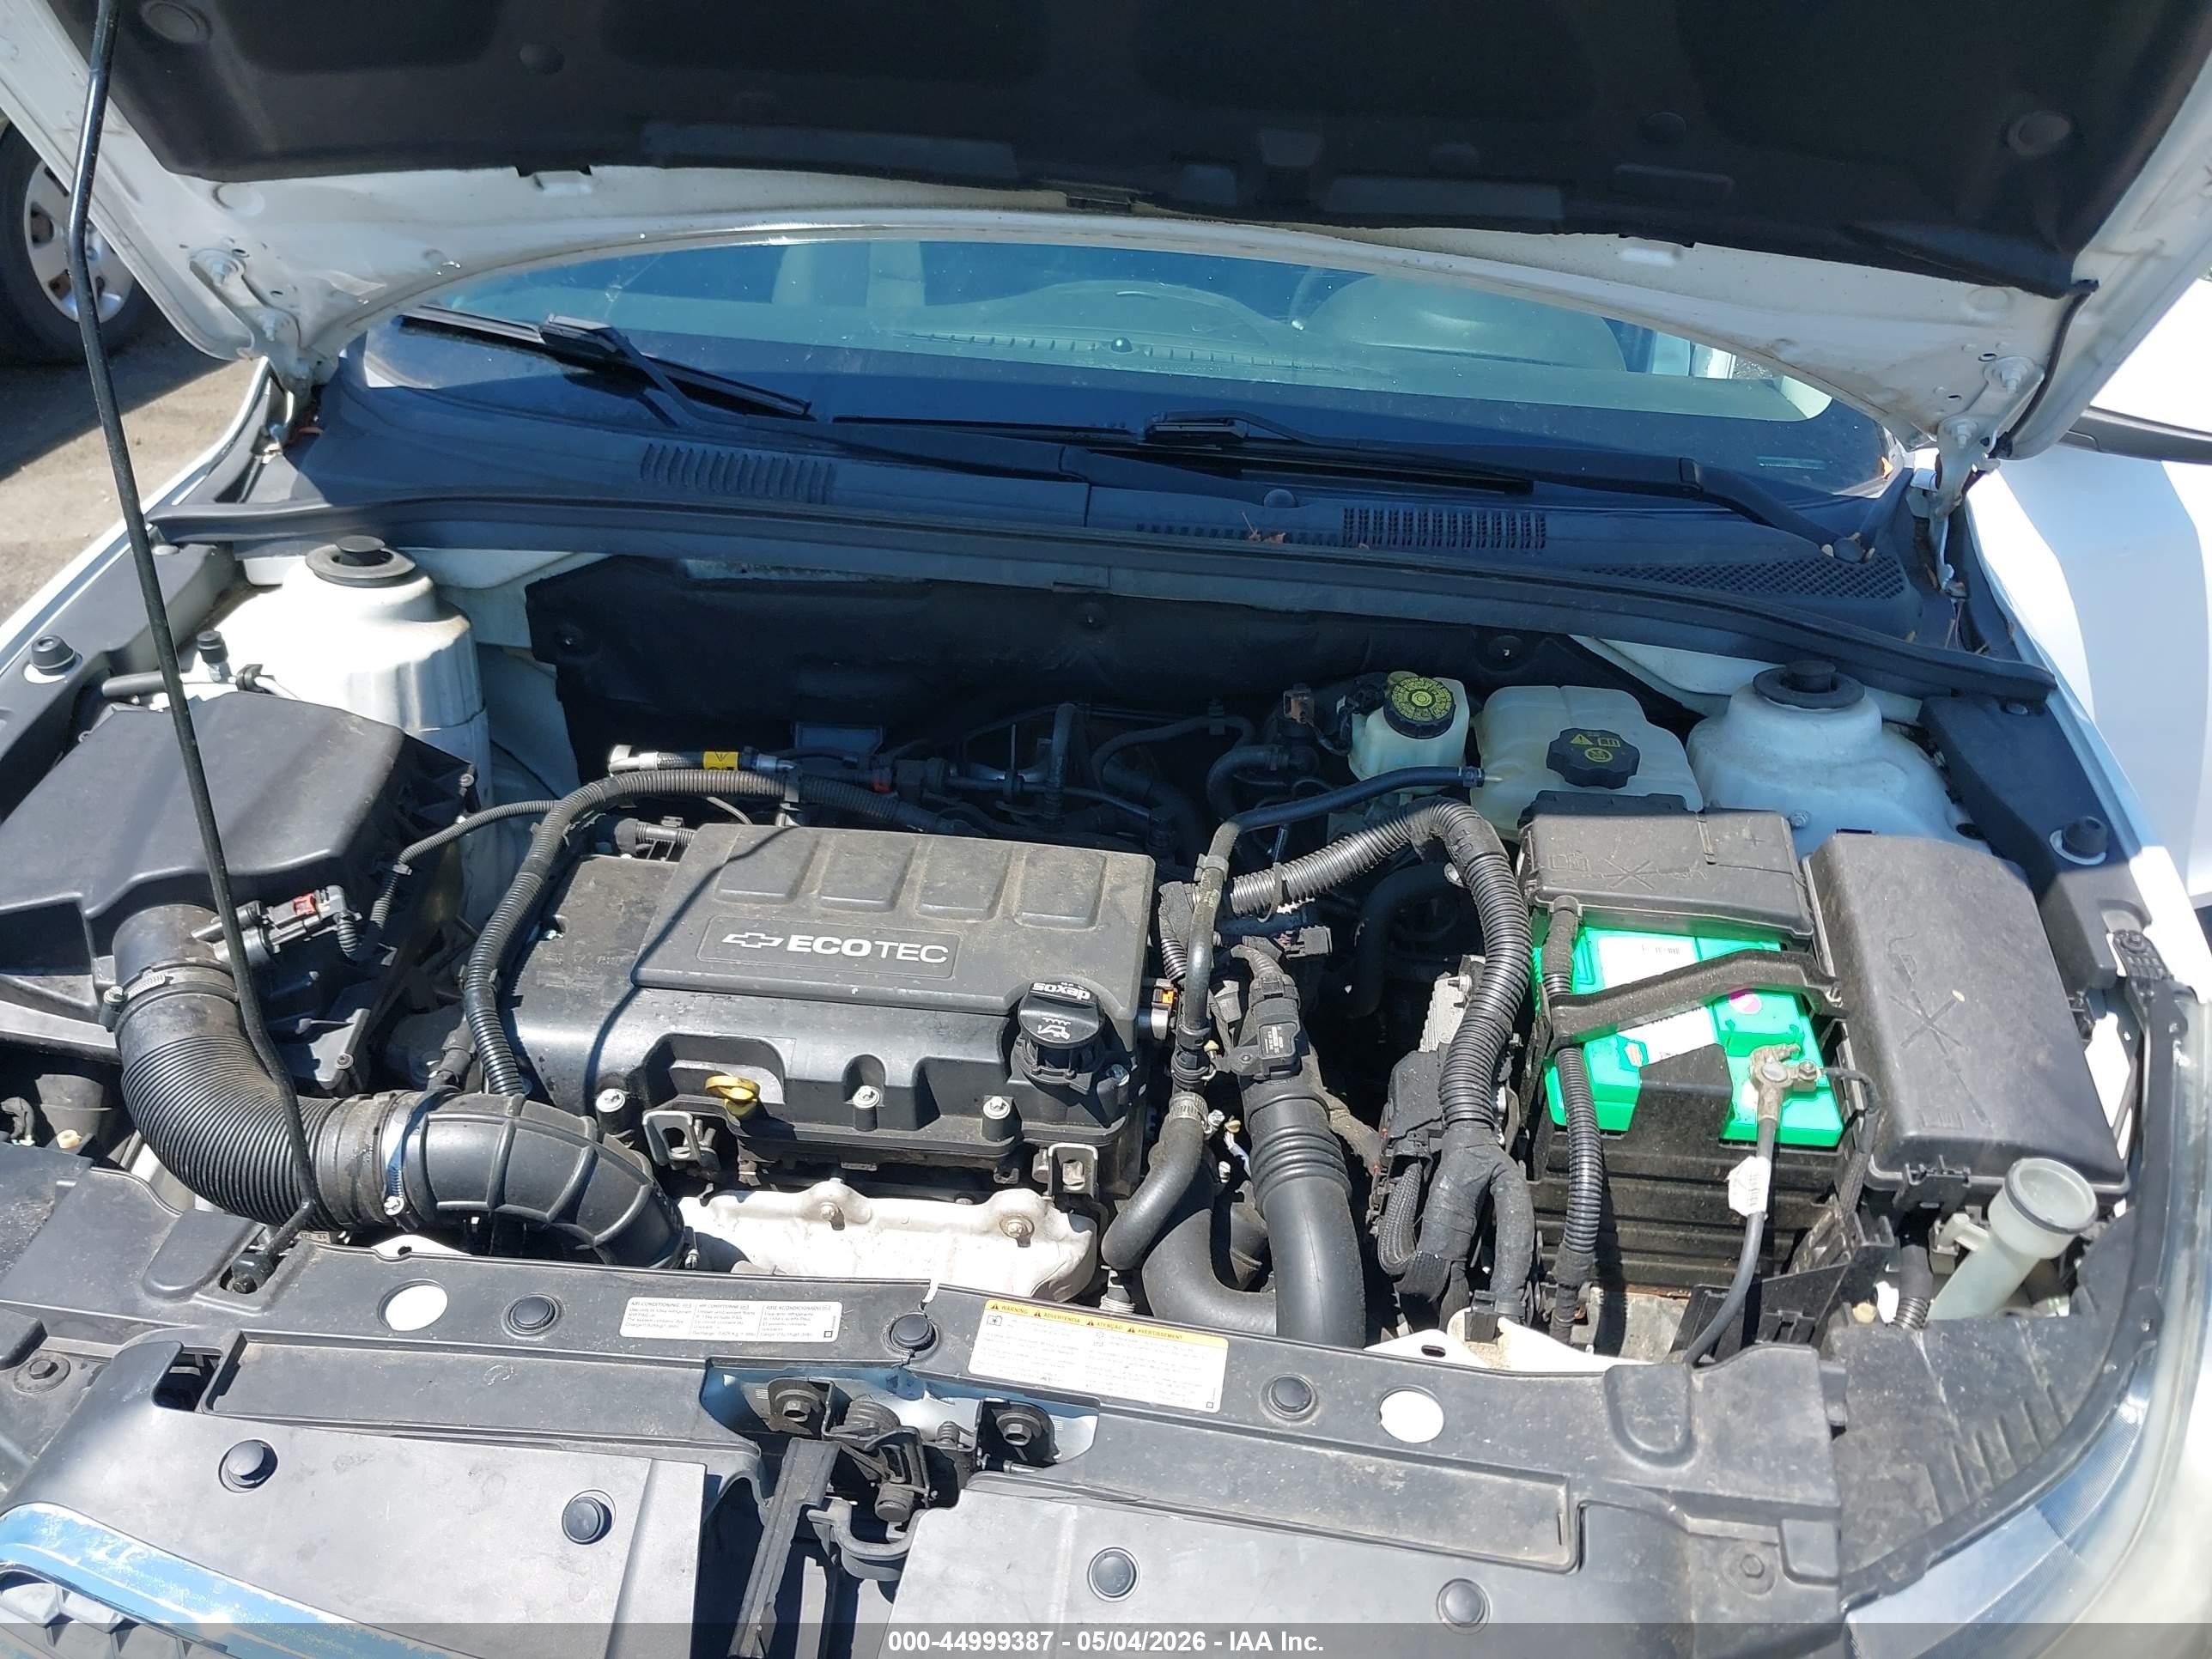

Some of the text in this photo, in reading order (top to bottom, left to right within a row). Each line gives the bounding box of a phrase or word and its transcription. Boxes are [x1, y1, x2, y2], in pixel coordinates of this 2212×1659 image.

[787, 934, 949, 963] ECOTEC
[1032, 982, 1091, 1000] dexos
[1001, 1304, 1029, 1315] WARNING
[1043, 1312, 1081, 1323] ADVERTENCIA
[1138, 1328, 1183, 1340] AVERTISSEMENT
